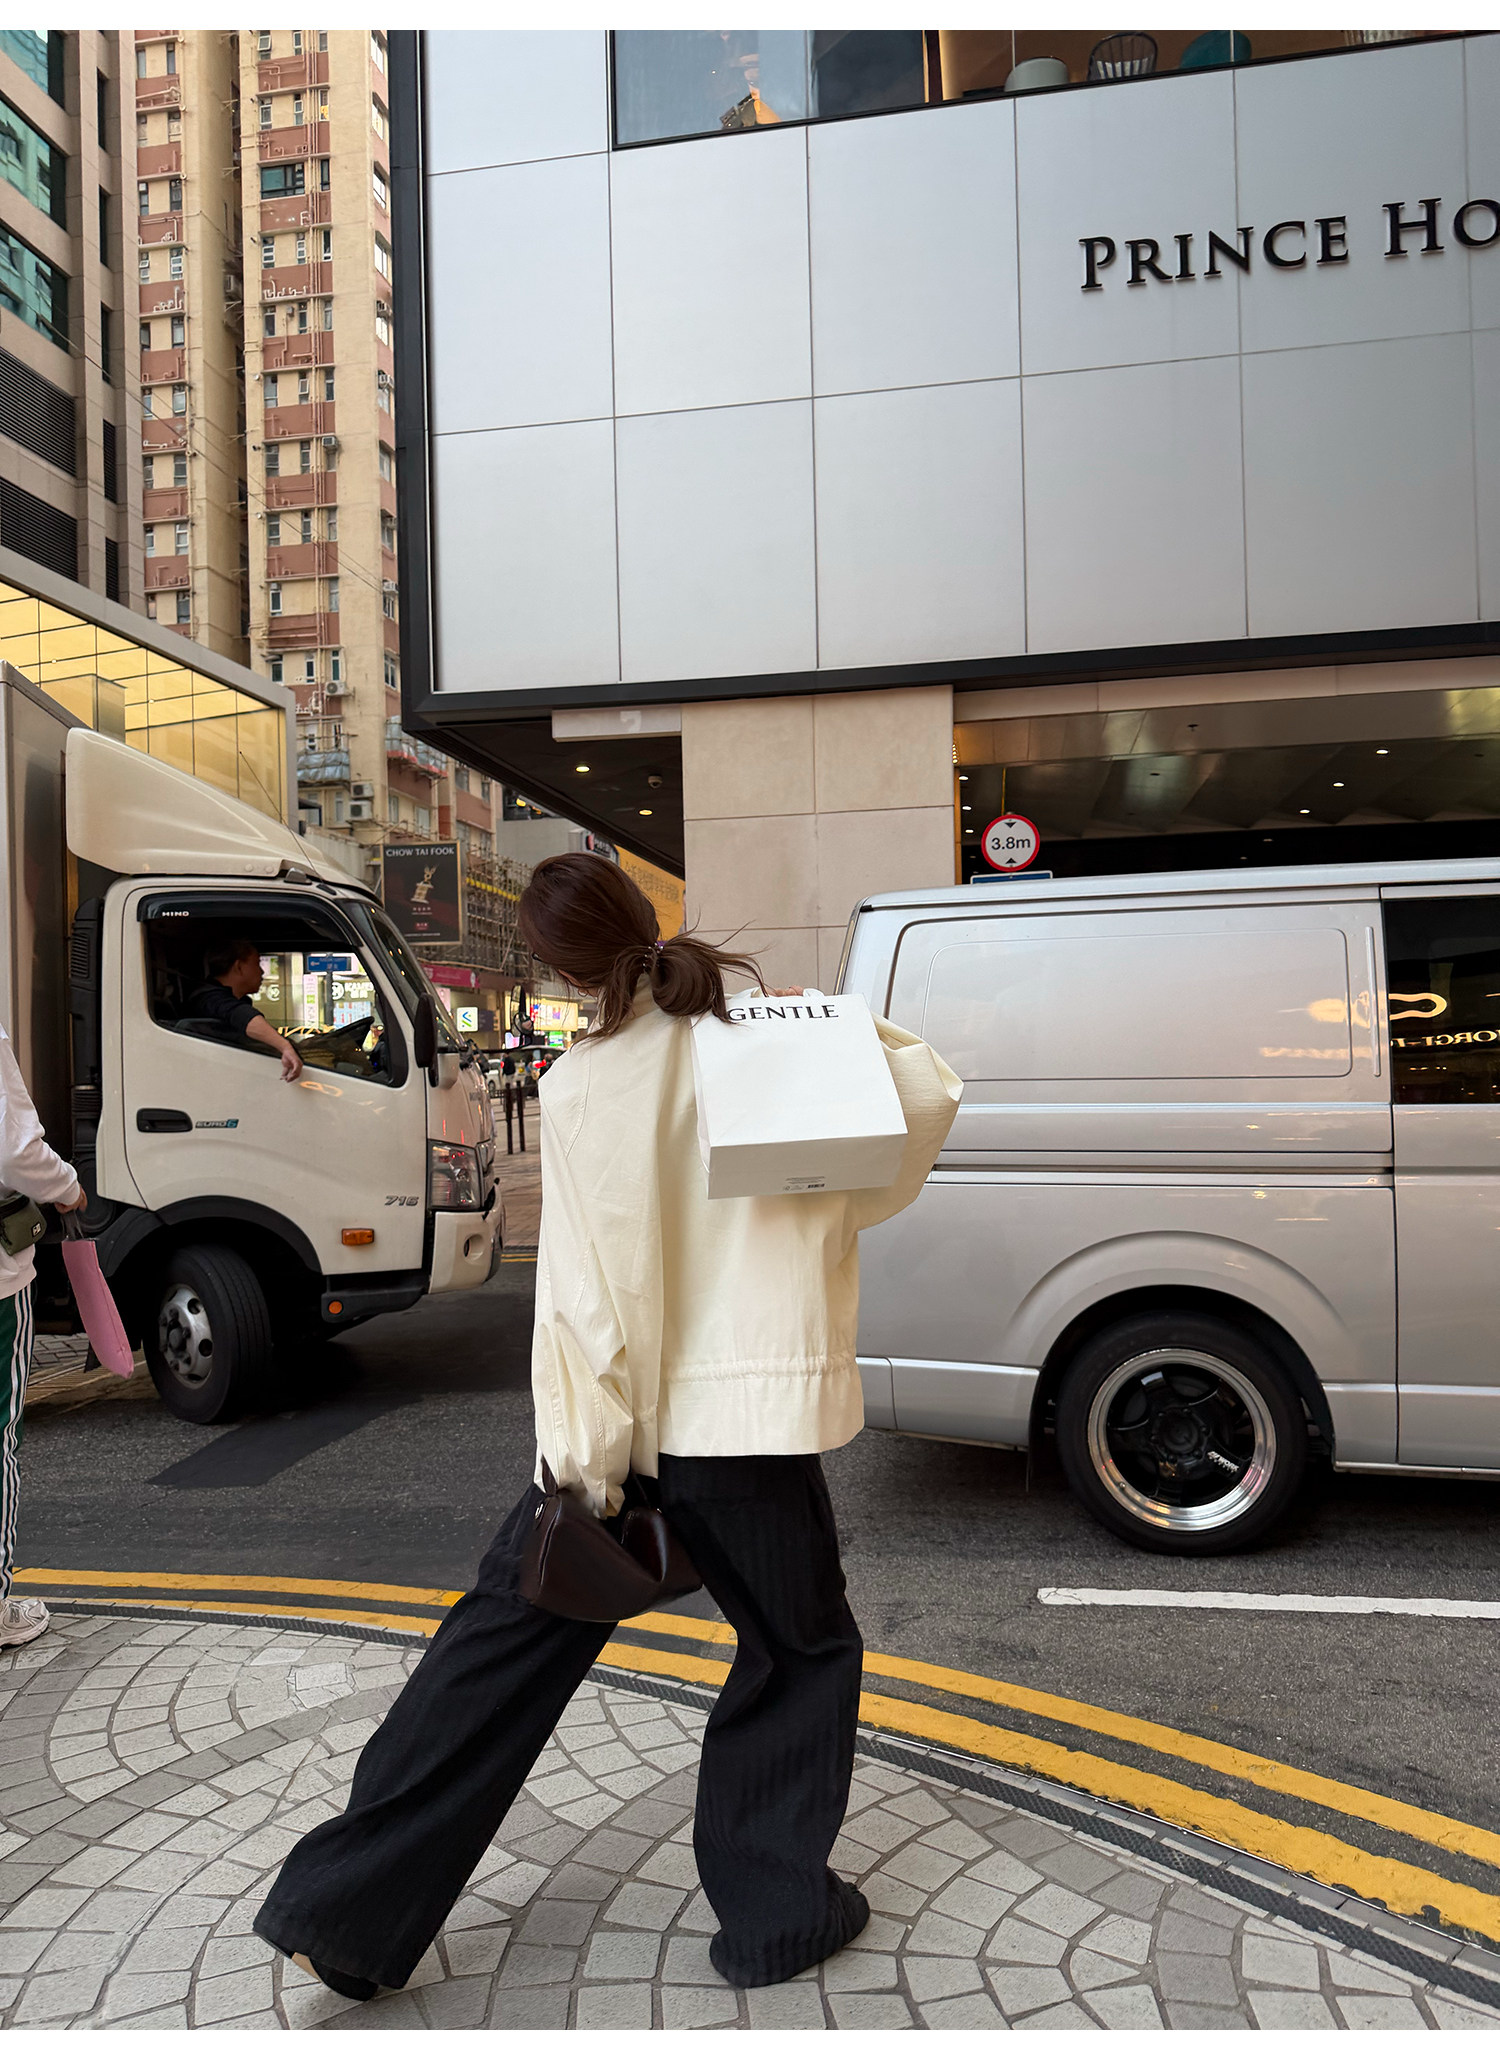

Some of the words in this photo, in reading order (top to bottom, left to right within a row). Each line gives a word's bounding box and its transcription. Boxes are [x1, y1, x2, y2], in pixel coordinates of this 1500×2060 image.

[1078, 214, 1349, 290] PRINCE
[991, 836, 1031, 851] 3.8m
[386, 848, 413, 857] CHOW
[415, 847, 429, 856] TAI
[431, 846, 455, 856] FOOK
[727, 1004, 839, 1021] GENTLE
[384, 1196, 419, 1206] 716
